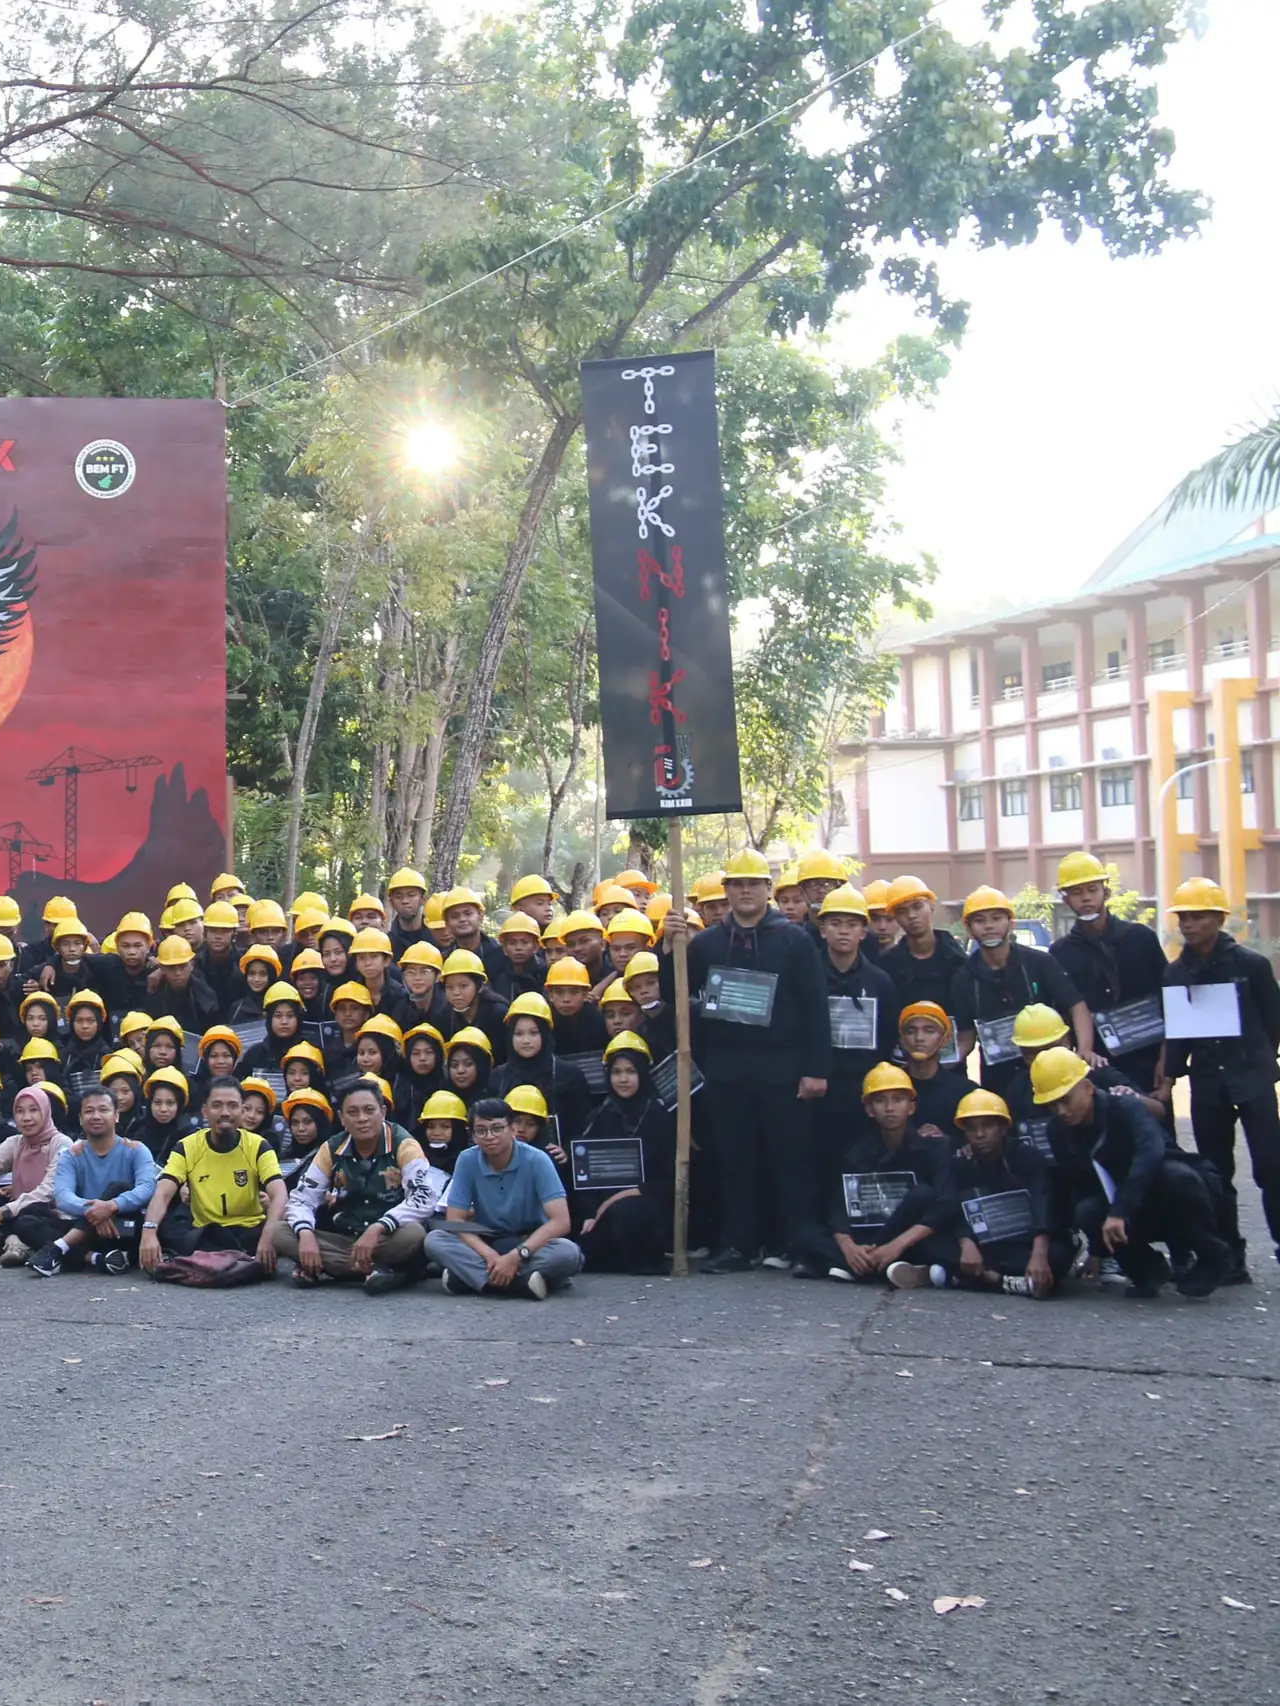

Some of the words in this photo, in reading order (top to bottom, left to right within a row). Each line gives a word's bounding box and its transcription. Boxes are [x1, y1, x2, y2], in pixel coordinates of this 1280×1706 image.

[85, 463, 110, 474] BEM
[111, 463, 126, 474] FT
[220, 1192, 228, 1217] 1
